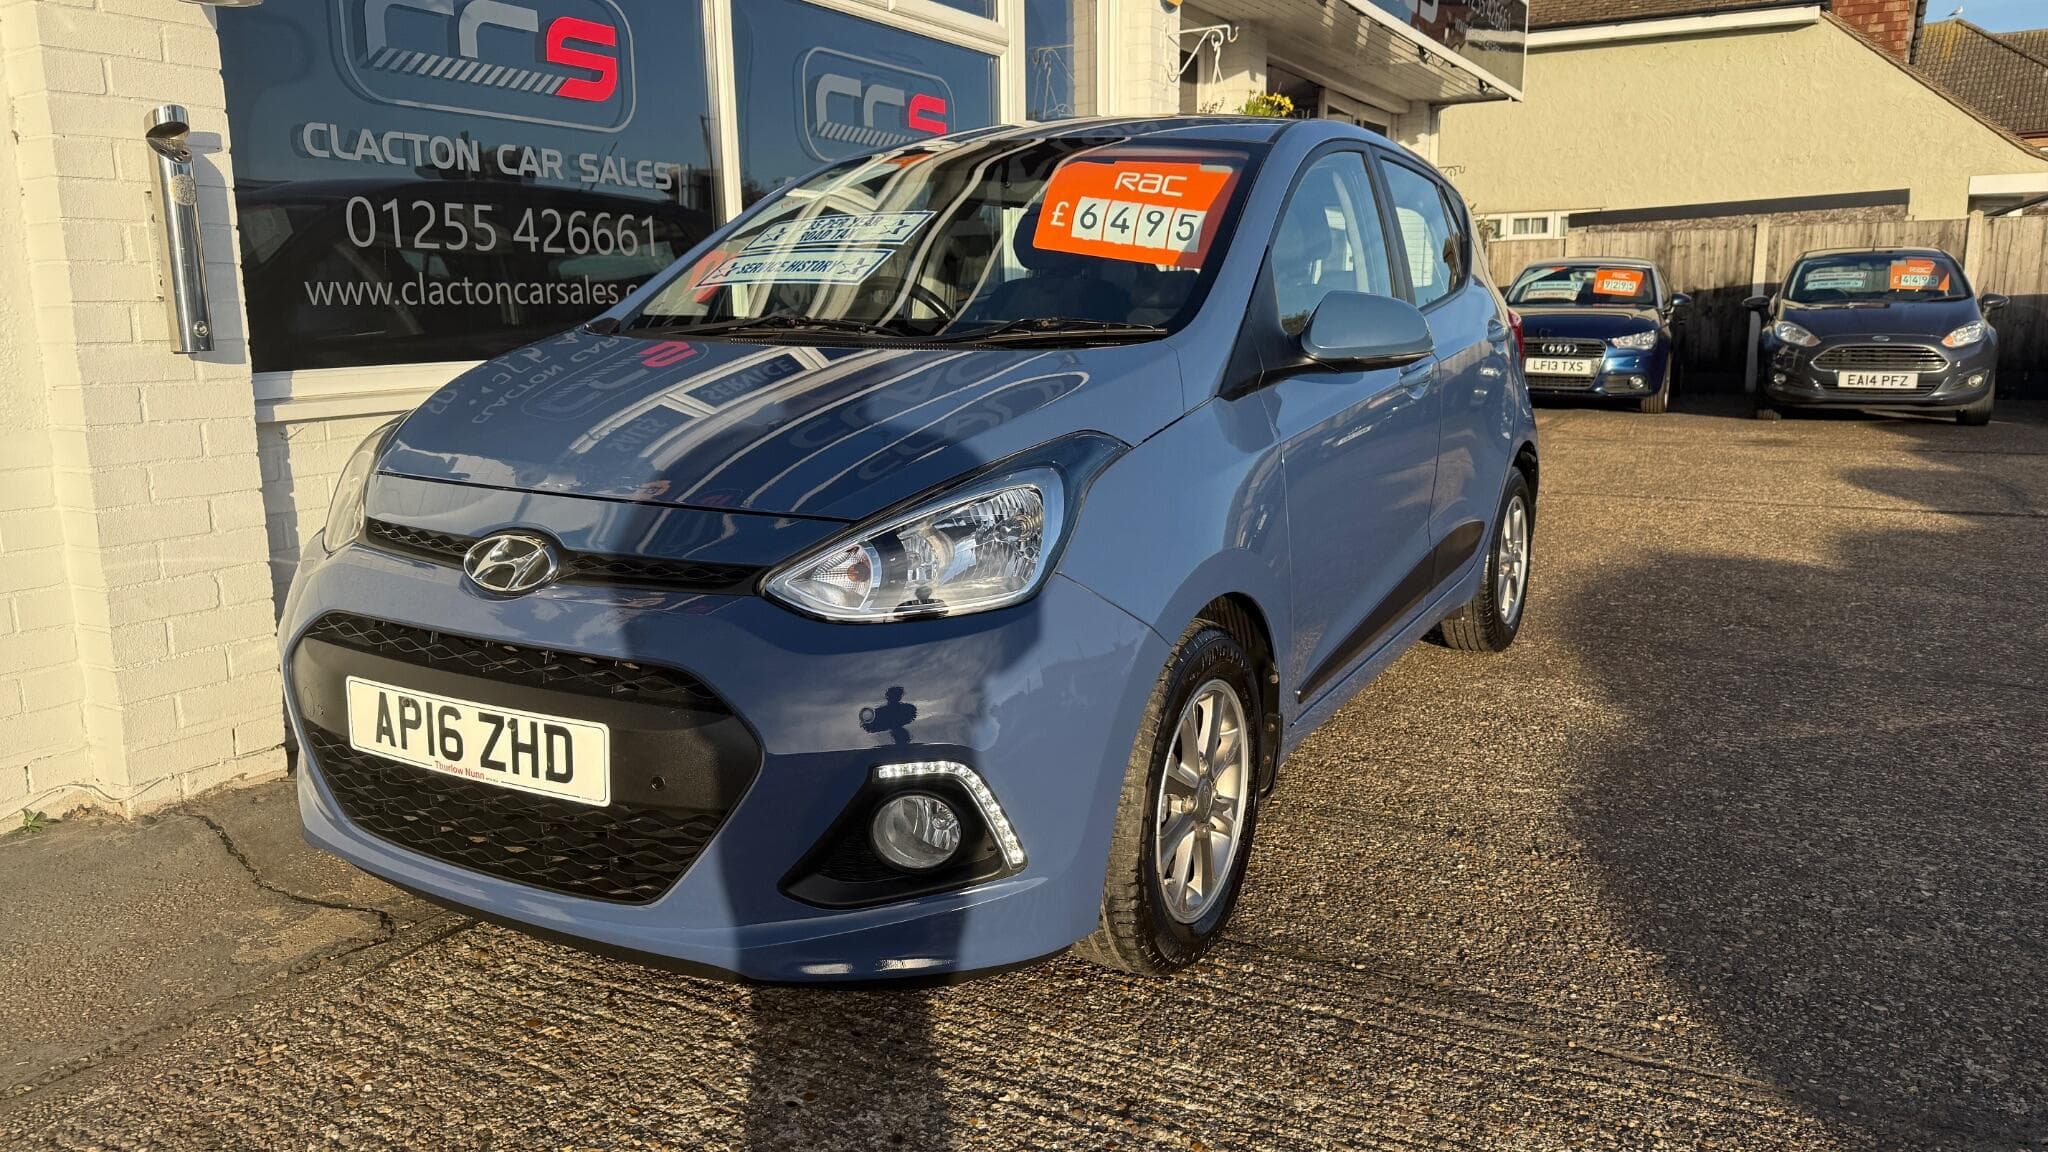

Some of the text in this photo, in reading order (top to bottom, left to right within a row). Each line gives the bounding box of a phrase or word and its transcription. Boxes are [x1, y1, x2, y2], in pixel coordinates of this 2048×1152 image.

[302, 122, 673, 190] CLACTON CAR SALES
[345, 196, 657, 257] 01255 426661
[735, 259, 842, 274] SERVICE HISTORY
[1533, 358, 1584, 372] LF13 TXS
[1847, 374, 1909, 387] EA14 PFZ
[375, 691, 574, 785] AP16 ZHD
[434, 760, 485, 780] Thurlow Nunn
